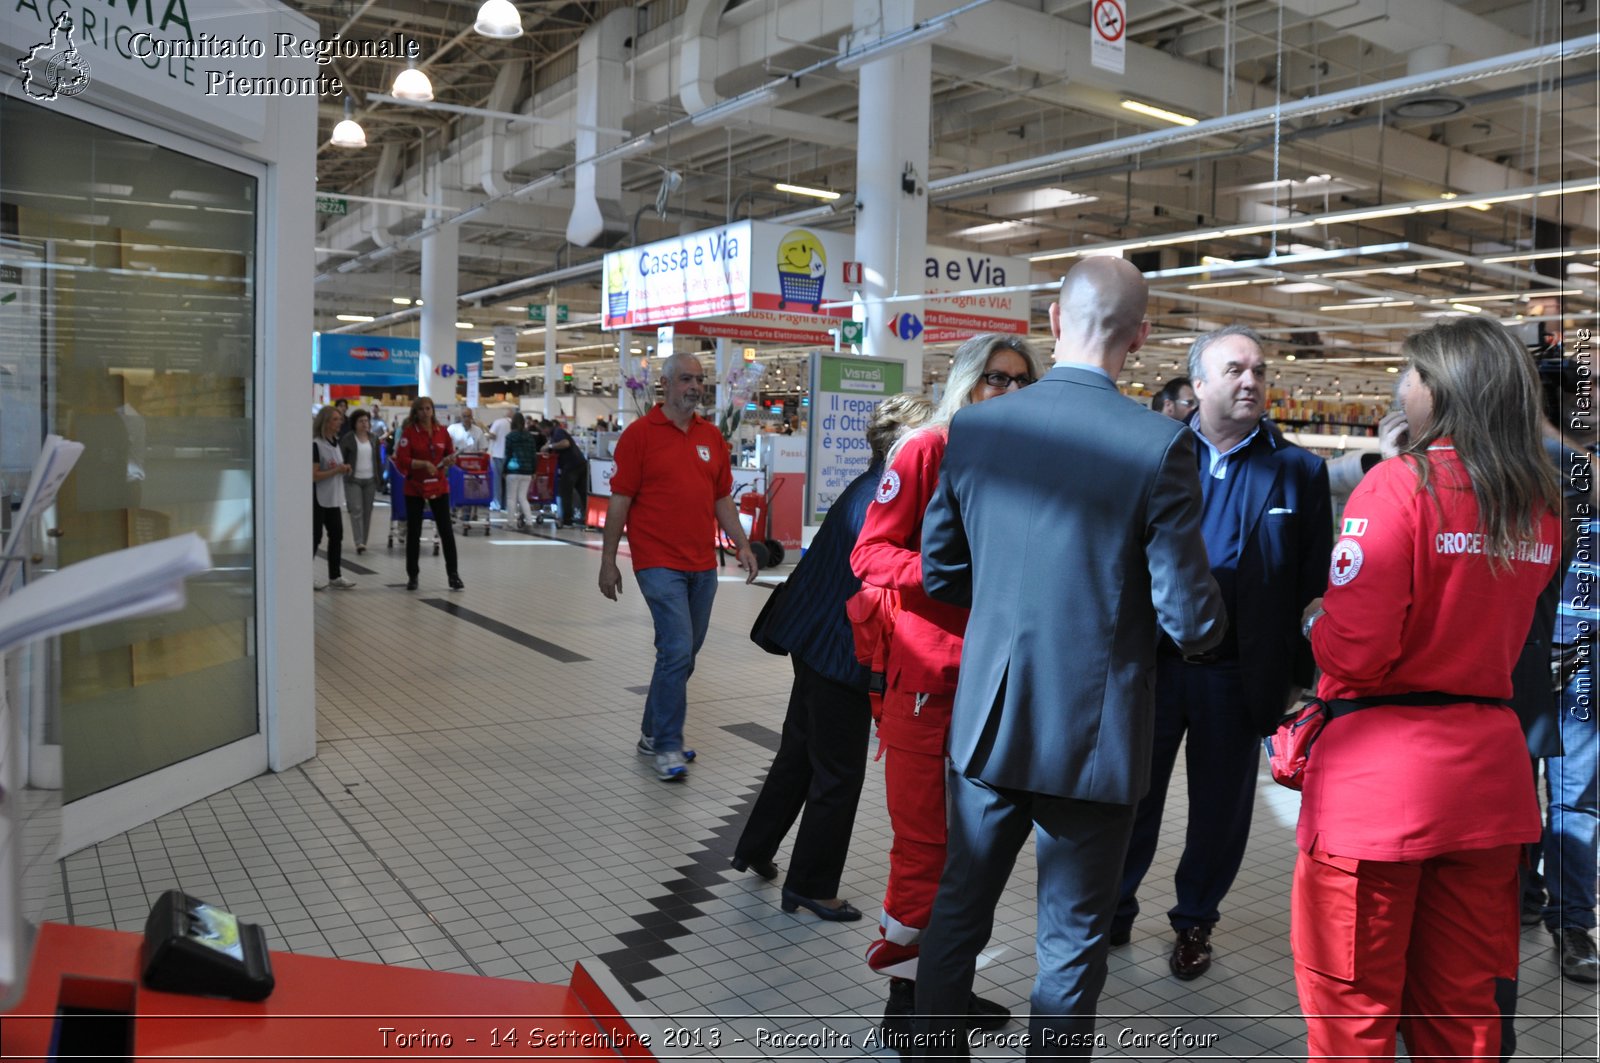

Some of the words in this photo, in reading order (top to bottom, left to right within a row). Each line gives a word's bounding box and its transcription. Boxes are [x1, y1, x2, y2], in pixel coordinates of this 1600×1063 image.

[639, 248, 689, 277] Cassa
[693, 245, 704, 266] e
[709, 230, 739, 262] Via
[946, 260, 961, 281] e
[966, 257, 1006, 287] Via
[699, 325, 739, 337] Pagamento
[740, 328, 753, 336] con
[753, 328, 773, 339] Carte
[774, 330, 814, 342] Elettroniche
[843, 398, 882, 416] repar
[823, 414, 836, 431] di
[823, 432, 832, 449] è
[1435, 532, 1482, 554] CROCE
